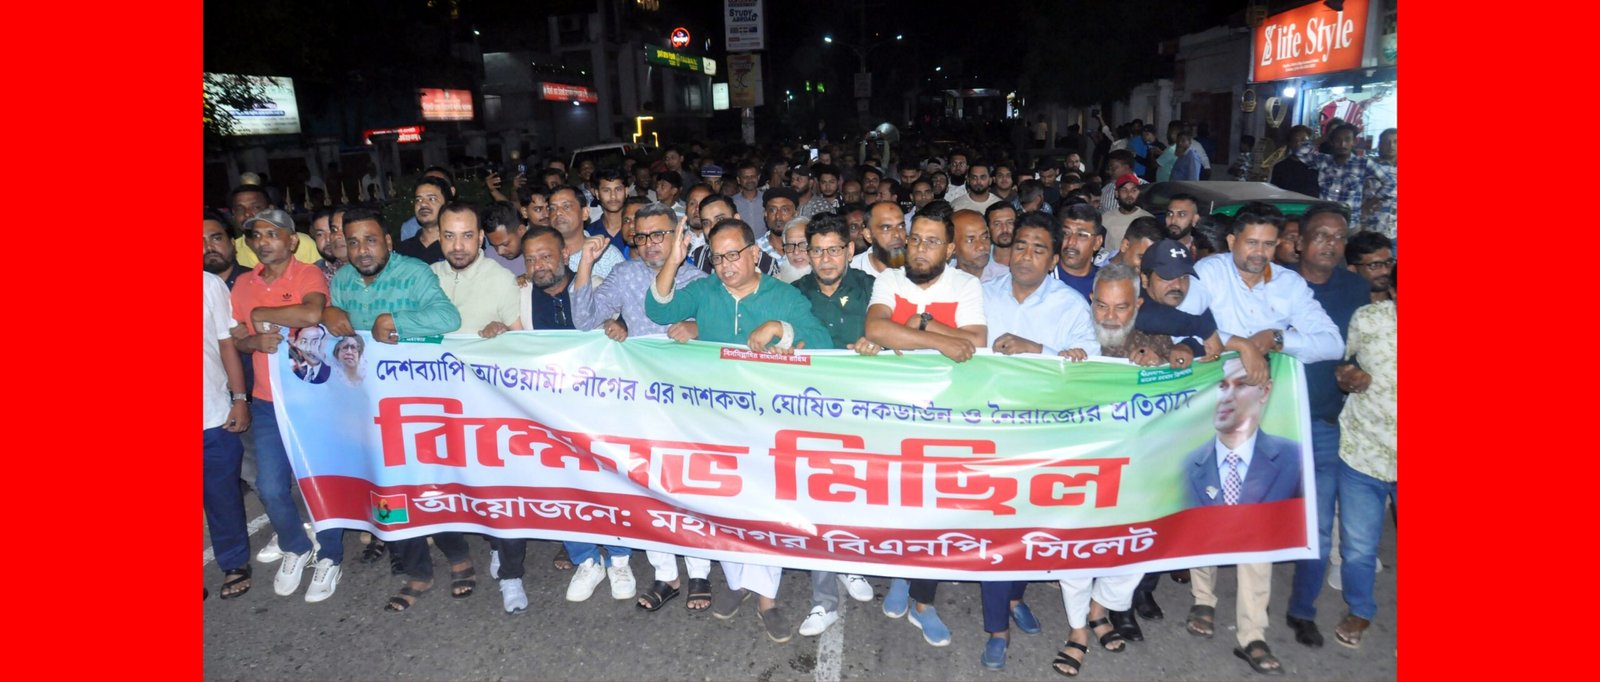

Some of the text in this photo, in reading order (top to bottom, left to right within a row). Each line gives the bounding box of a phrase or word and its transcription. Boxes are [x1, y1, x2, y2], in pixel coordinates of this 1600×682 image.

[729, 9, 752, 17] STUDY
[732, 14, 757, 22] ABROAD
[1276, 11, 1354, 62] life Style
[377, 352, 465, 382] দেশব্যাপি
[470, 363, 565, 394] আওয়ামী
[571, 366, 638, 401] লীগের
[645, 381, 674, 403] এর
[680, 385, 764, 416] নাশকতা,
[771, 387, 845, 418] ঘোষিত
[851, 399, 952, 423] লকডাউন
[961, 408, 981, 424] ও
[987, 400, 1102, 424] নৈরাজ্যের
[374, 397, 1130, 516] বিক্ষোভ মিছিল
[647, 509, 809, 550] মহানগর
[822, 530, 1004, 565] বিএনপি,
[1022, 527, 1158, 560] সিলেট
